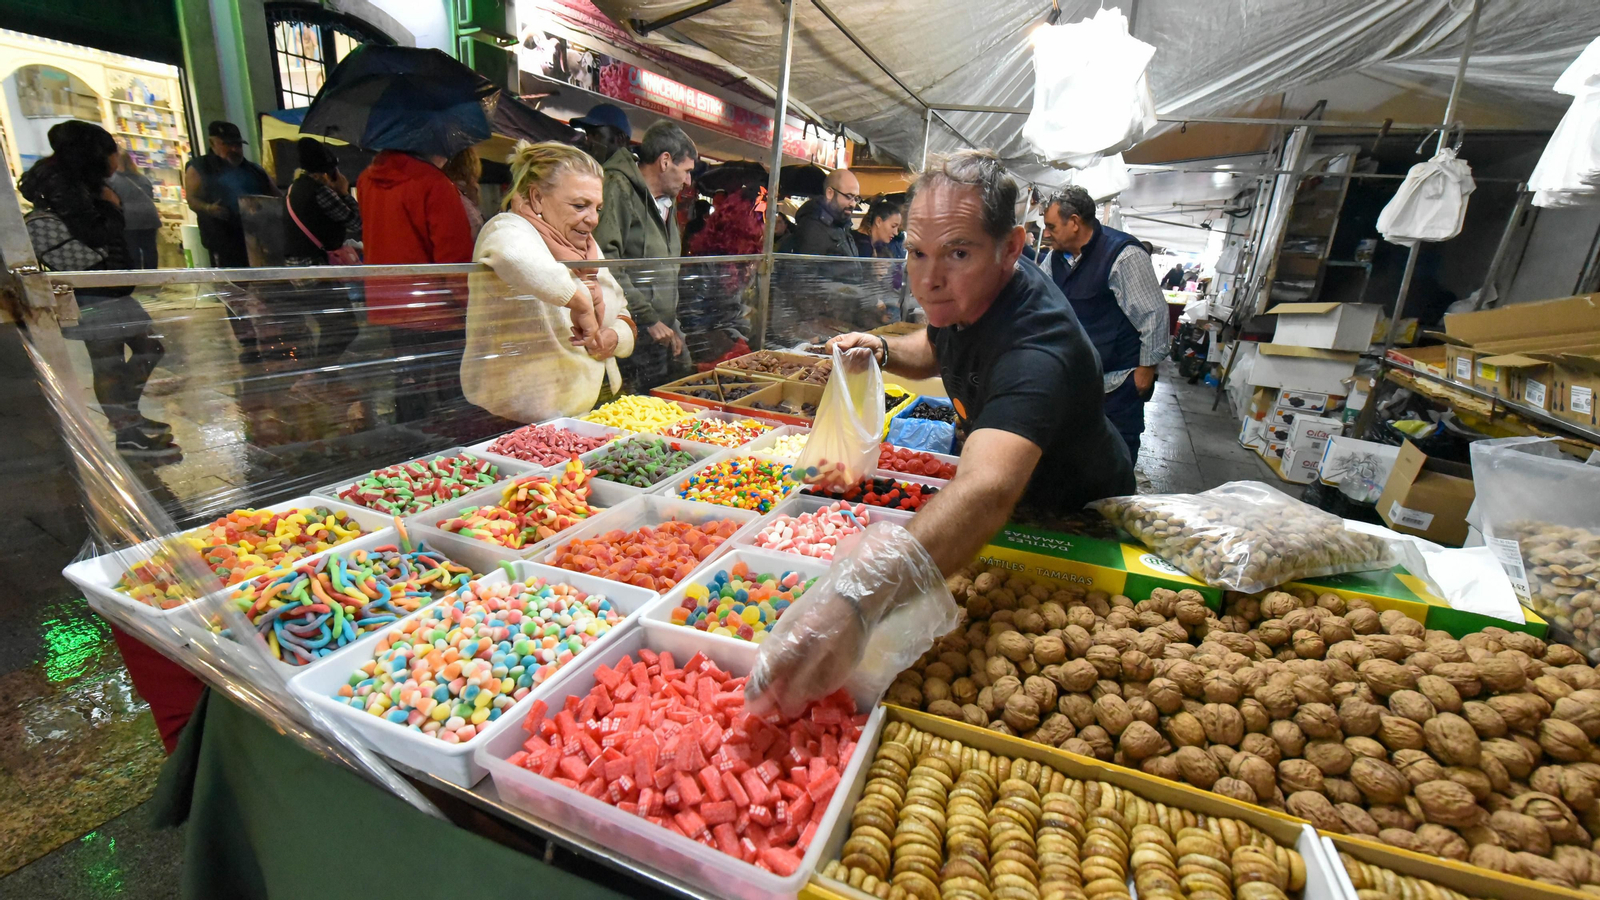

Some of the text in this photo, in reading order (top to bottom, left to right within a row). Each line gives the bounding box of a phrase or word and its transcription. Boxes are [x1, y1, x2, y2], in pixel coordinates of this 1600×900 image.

[686, 89, 696, 107] EL
[1004, 530, 1074, 547] TAMARAS
[1007, 536, 1069, 552] DATILES
[1036, 567, 1093, 586] TAMARAS
